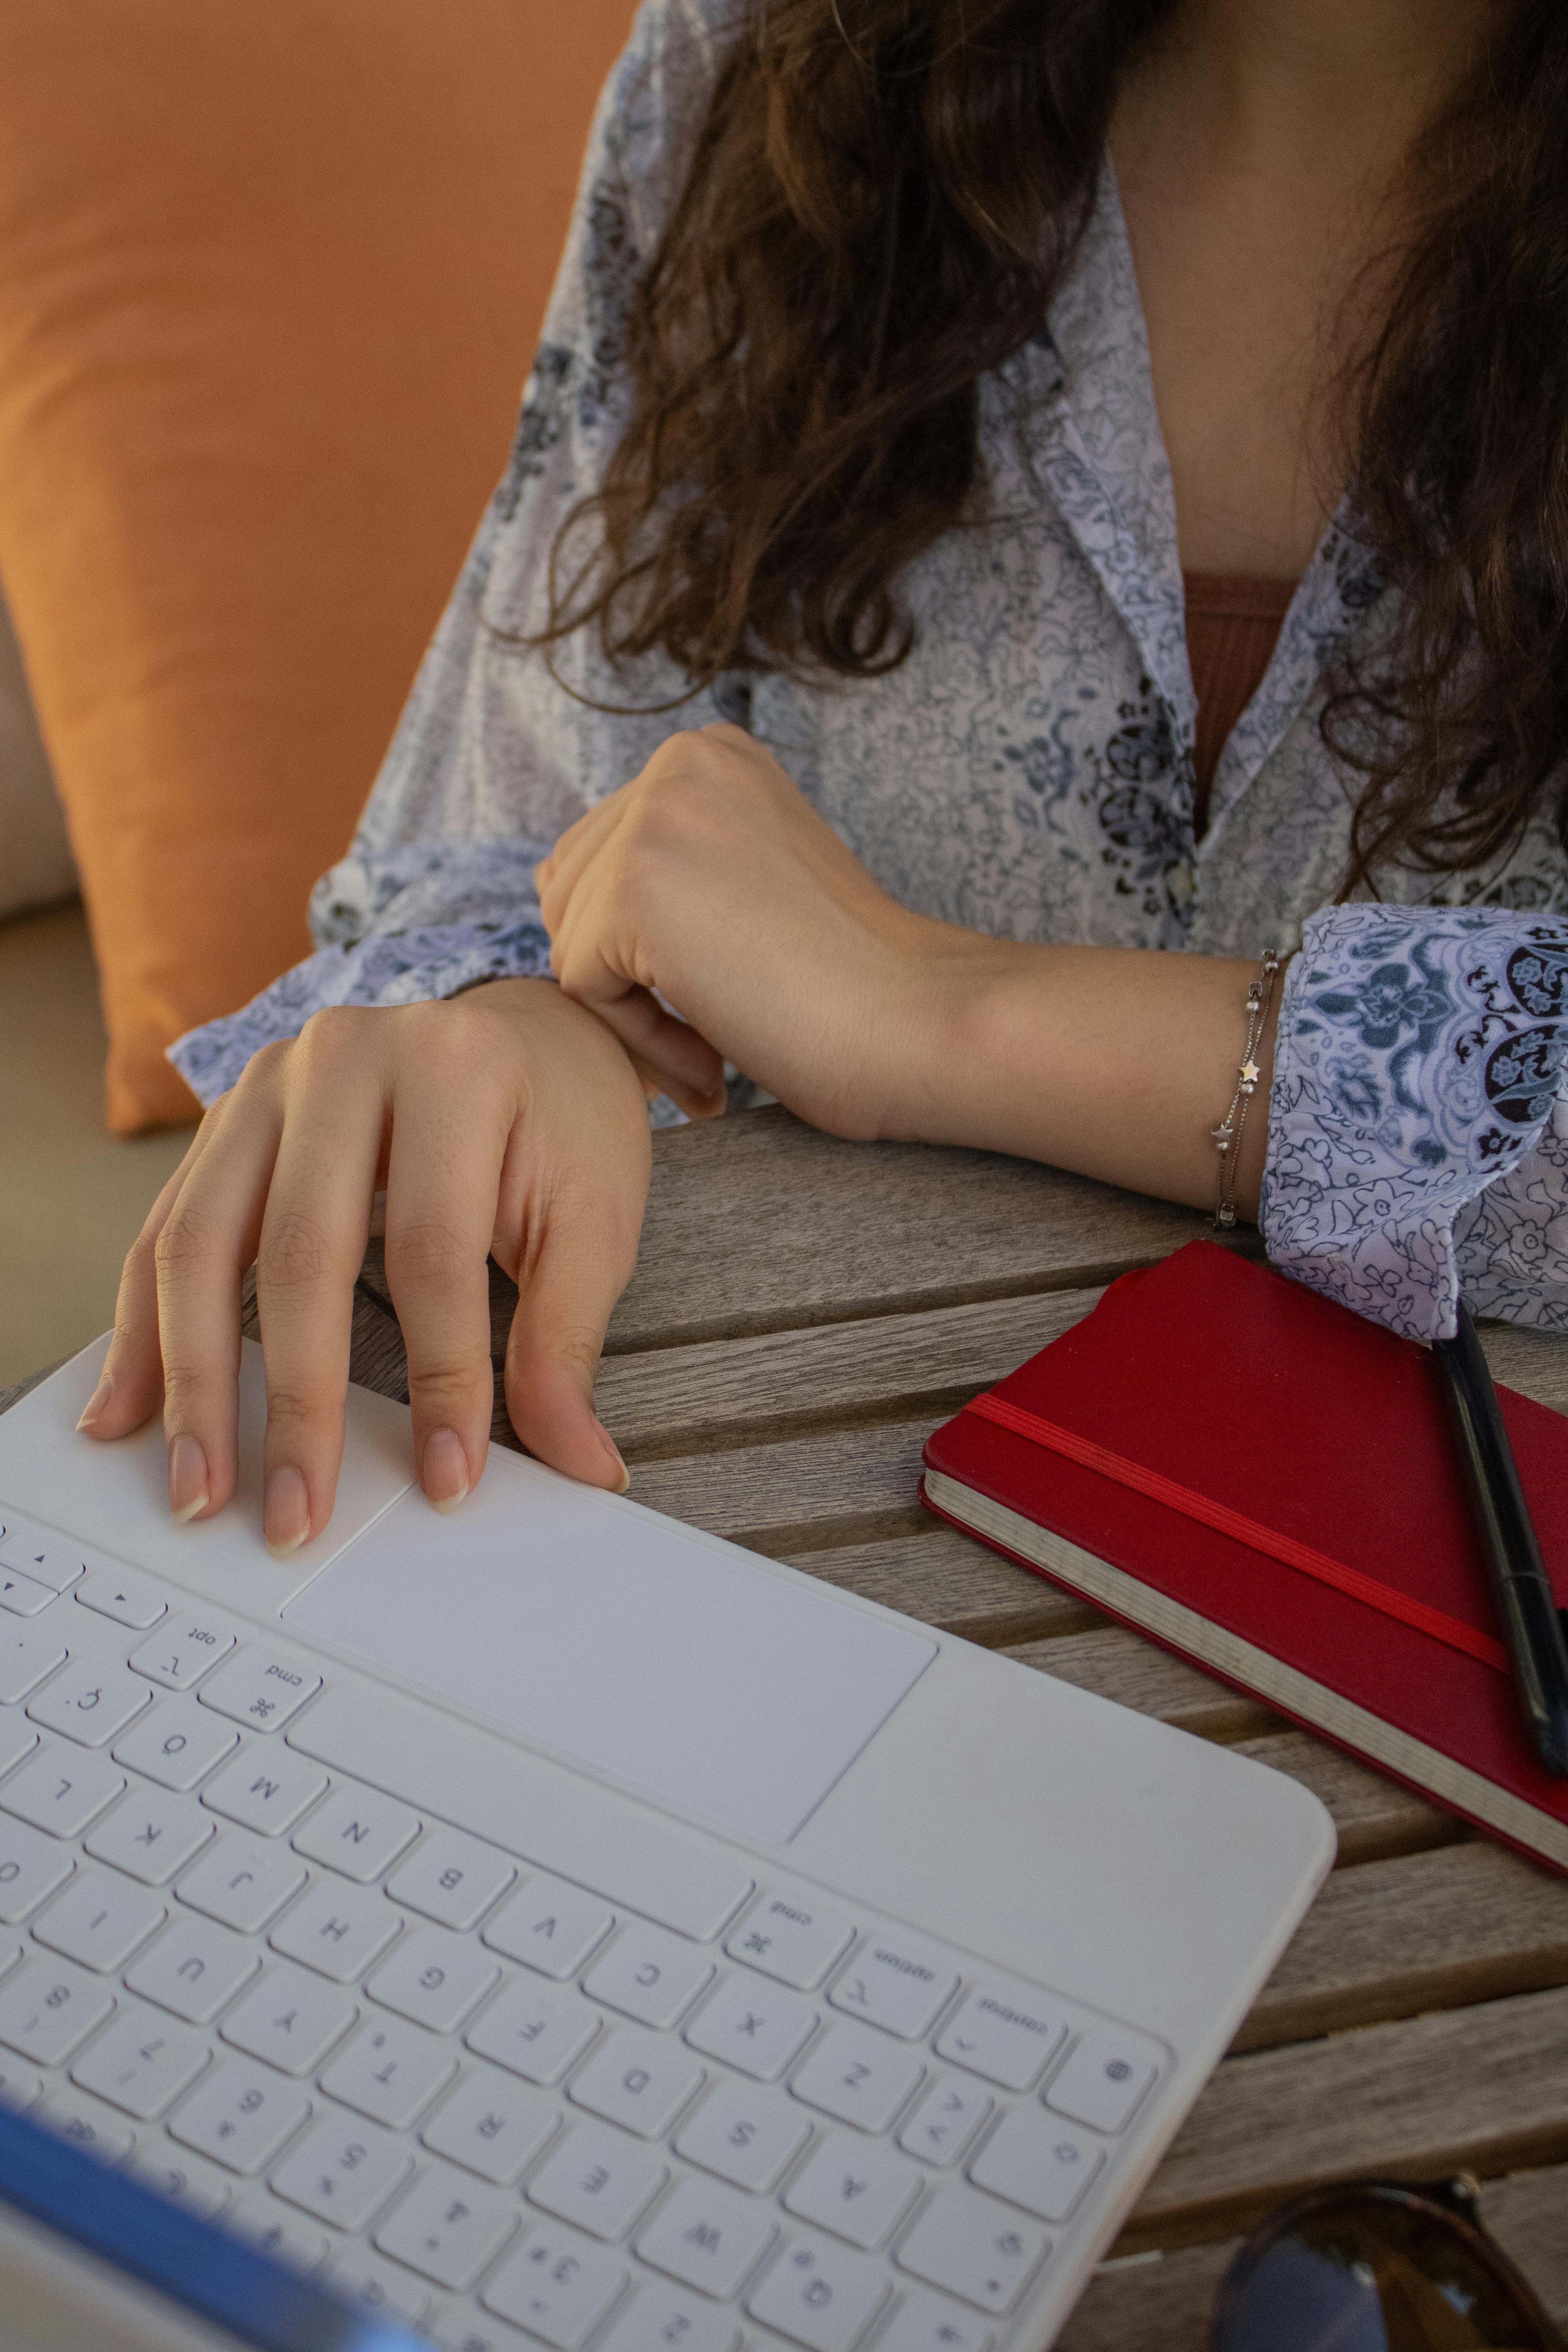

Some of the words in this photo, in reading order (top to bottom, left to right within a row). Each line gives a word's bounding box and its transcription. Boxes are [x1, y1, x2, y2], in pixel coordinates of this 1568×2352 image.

[188, 1627, 217, 1645] opt
[264, 1664, 303, 1686] cmd
[76, 1688, 103, 1711] Ç
[55, 1778, 73, 1800] L
[249, 1776, 280, 1800] M
[136, 1823, 162, 1846] K
[342, 1821, 370, 1844] N
[229, 1871, 254, 1890] J
[438, 1868, 464, 1891] B
[89, 1910, 108, 1931] I
[769, 1900, 813, 1926] cmd
[320, 1917, 350, 1943] H
[533, 1916, 557, 1940] V
[177, 1957, 206, 1983] U
[634, 1963, 661, 1987] C
[873, 1948, 935, 1983] option
[420, 1967, 445, 1990] G
[45, 1985, 71, 2009] 8
[274, 2010, 297, 2033] Y
[737, 2012, 764, 2038] X
[976, 1997, 1049, 2036] control
[519, 2022, 545, 2042] F
[139, 2039, 165, 2062] 7
[373, 2062, 397, 2086] T
[624, 2071, 649, 2093] D
[842, 2062, 872, 2090] Z
[239, 2089, 264, 2112] 6
[477, 2114, 504, 2139] R
[728, 2120, 757, 2148] S
[342, 2145, 366, 2169] 5
[582, 2165, 611, 2195] E
[842, 2176, 867, 2201] A
[447, 2202, 467, 2221] 4
[684, 2222, 721, 2254] W
[554, 2257, 579, 2281] 3
